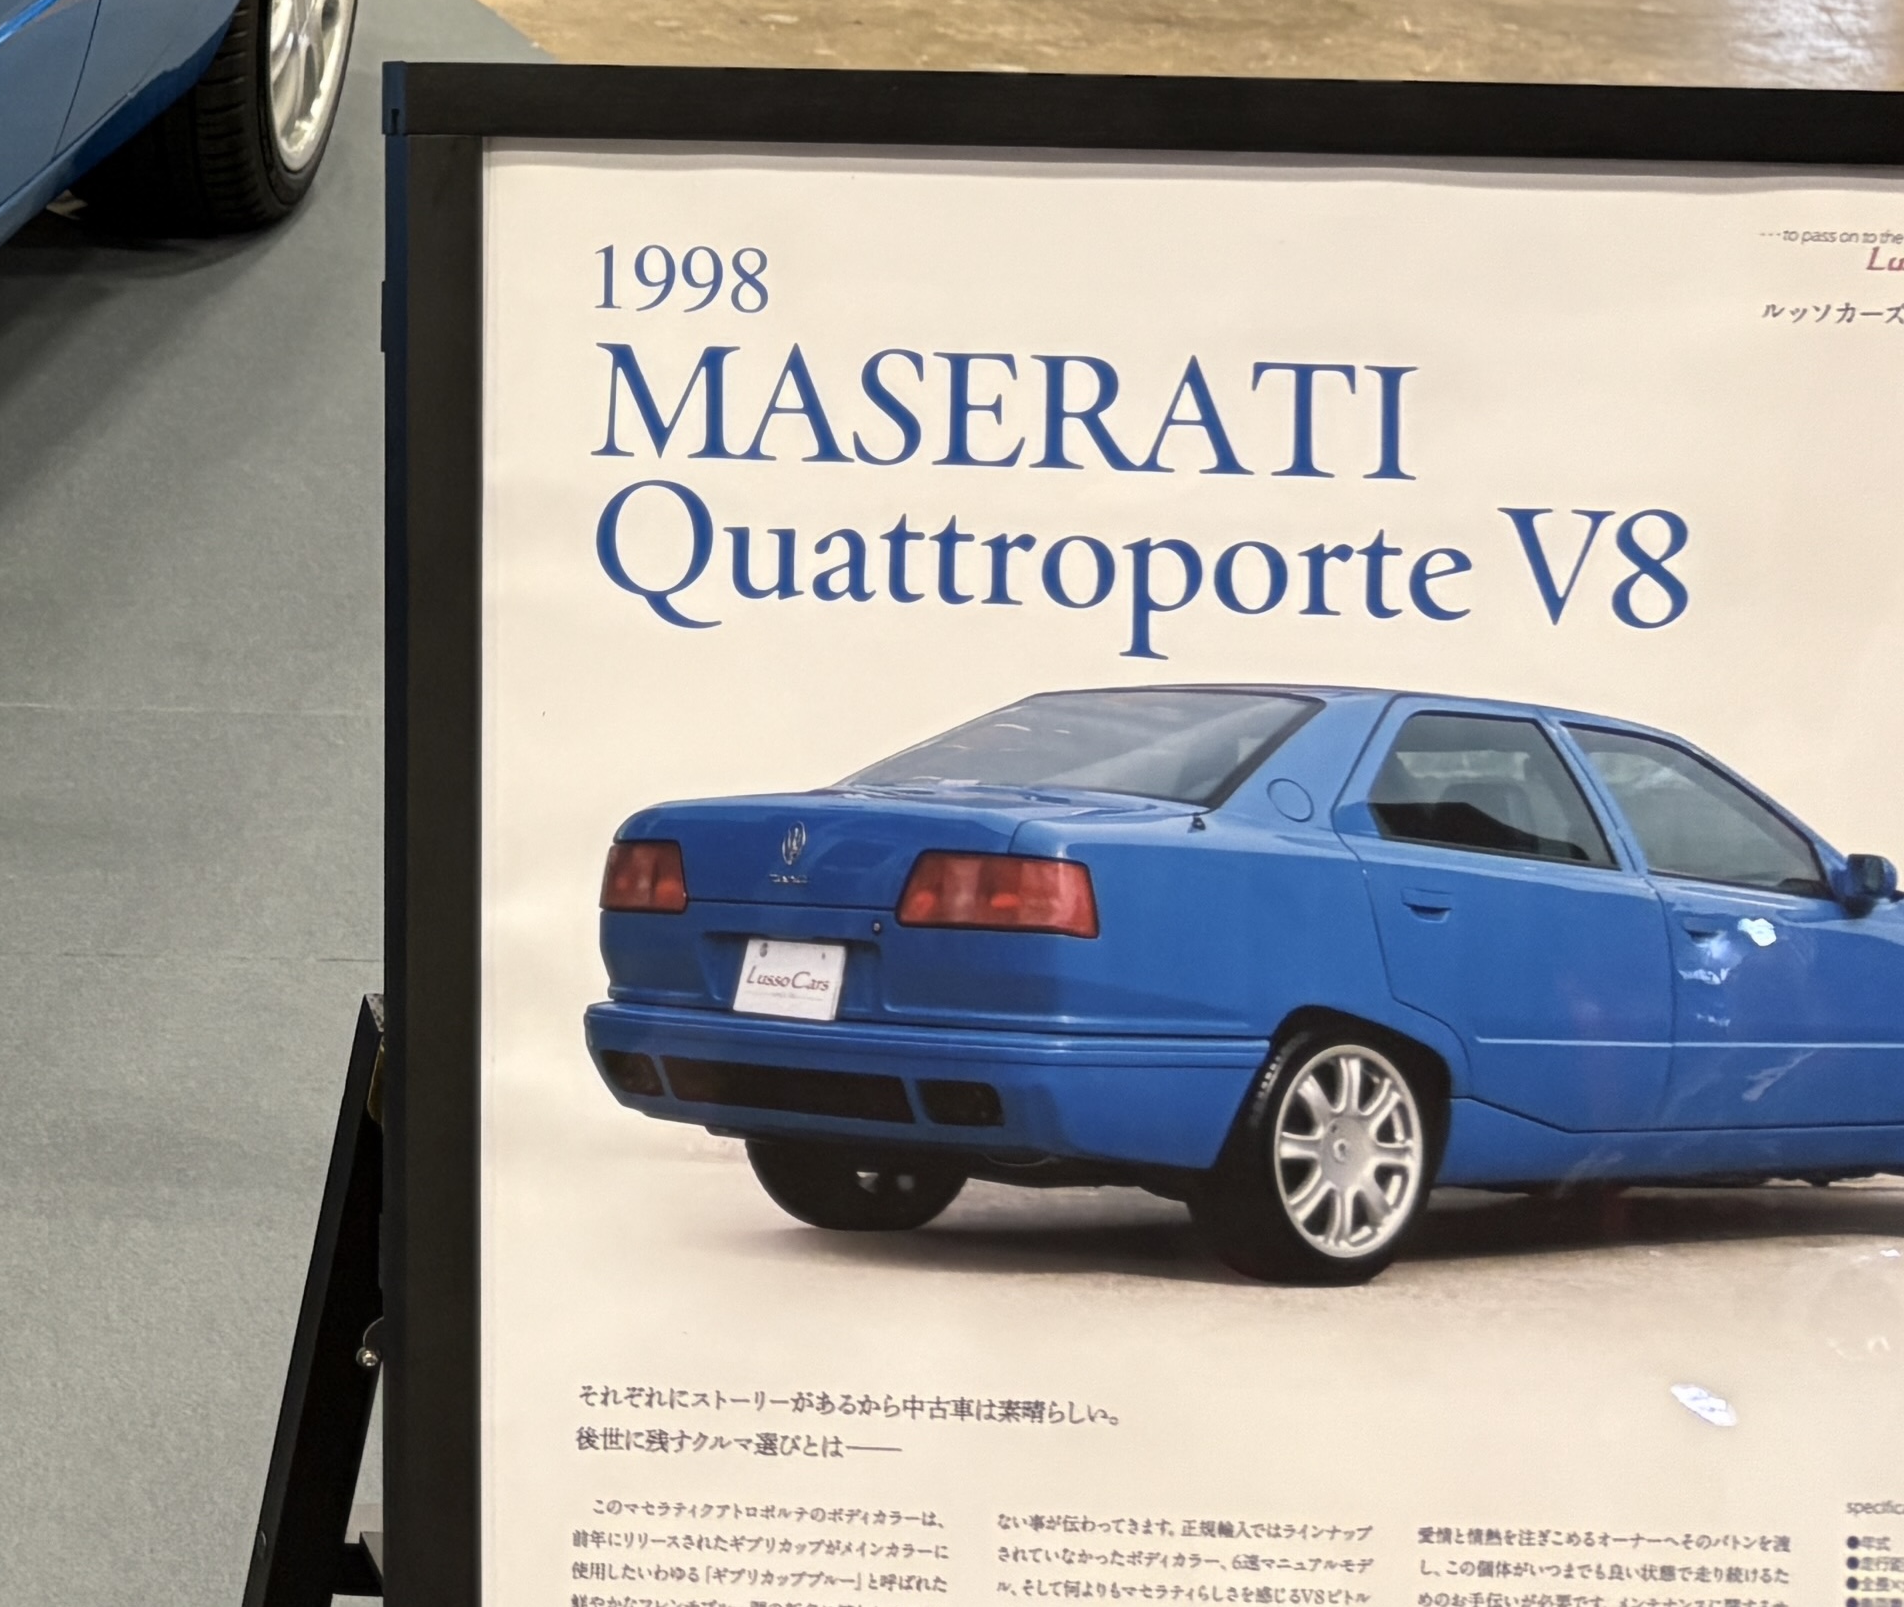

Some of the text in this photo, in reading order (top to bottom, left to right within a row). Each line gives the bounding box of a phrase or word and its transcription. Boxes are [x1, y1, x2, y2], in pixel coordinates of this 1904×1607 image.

[1801, 230, 1837, 245] pass
[1839, 231, 1860, 244] on
[595, 245, 768, 314] 1998
[591, 343, 1419, 480] MASERATI
[595, 481, 1689, 659] Quattroporte V8
[578, 1384, 1119, 1426] それぞれにストーリーがあるから中古車は素晴らしい。
